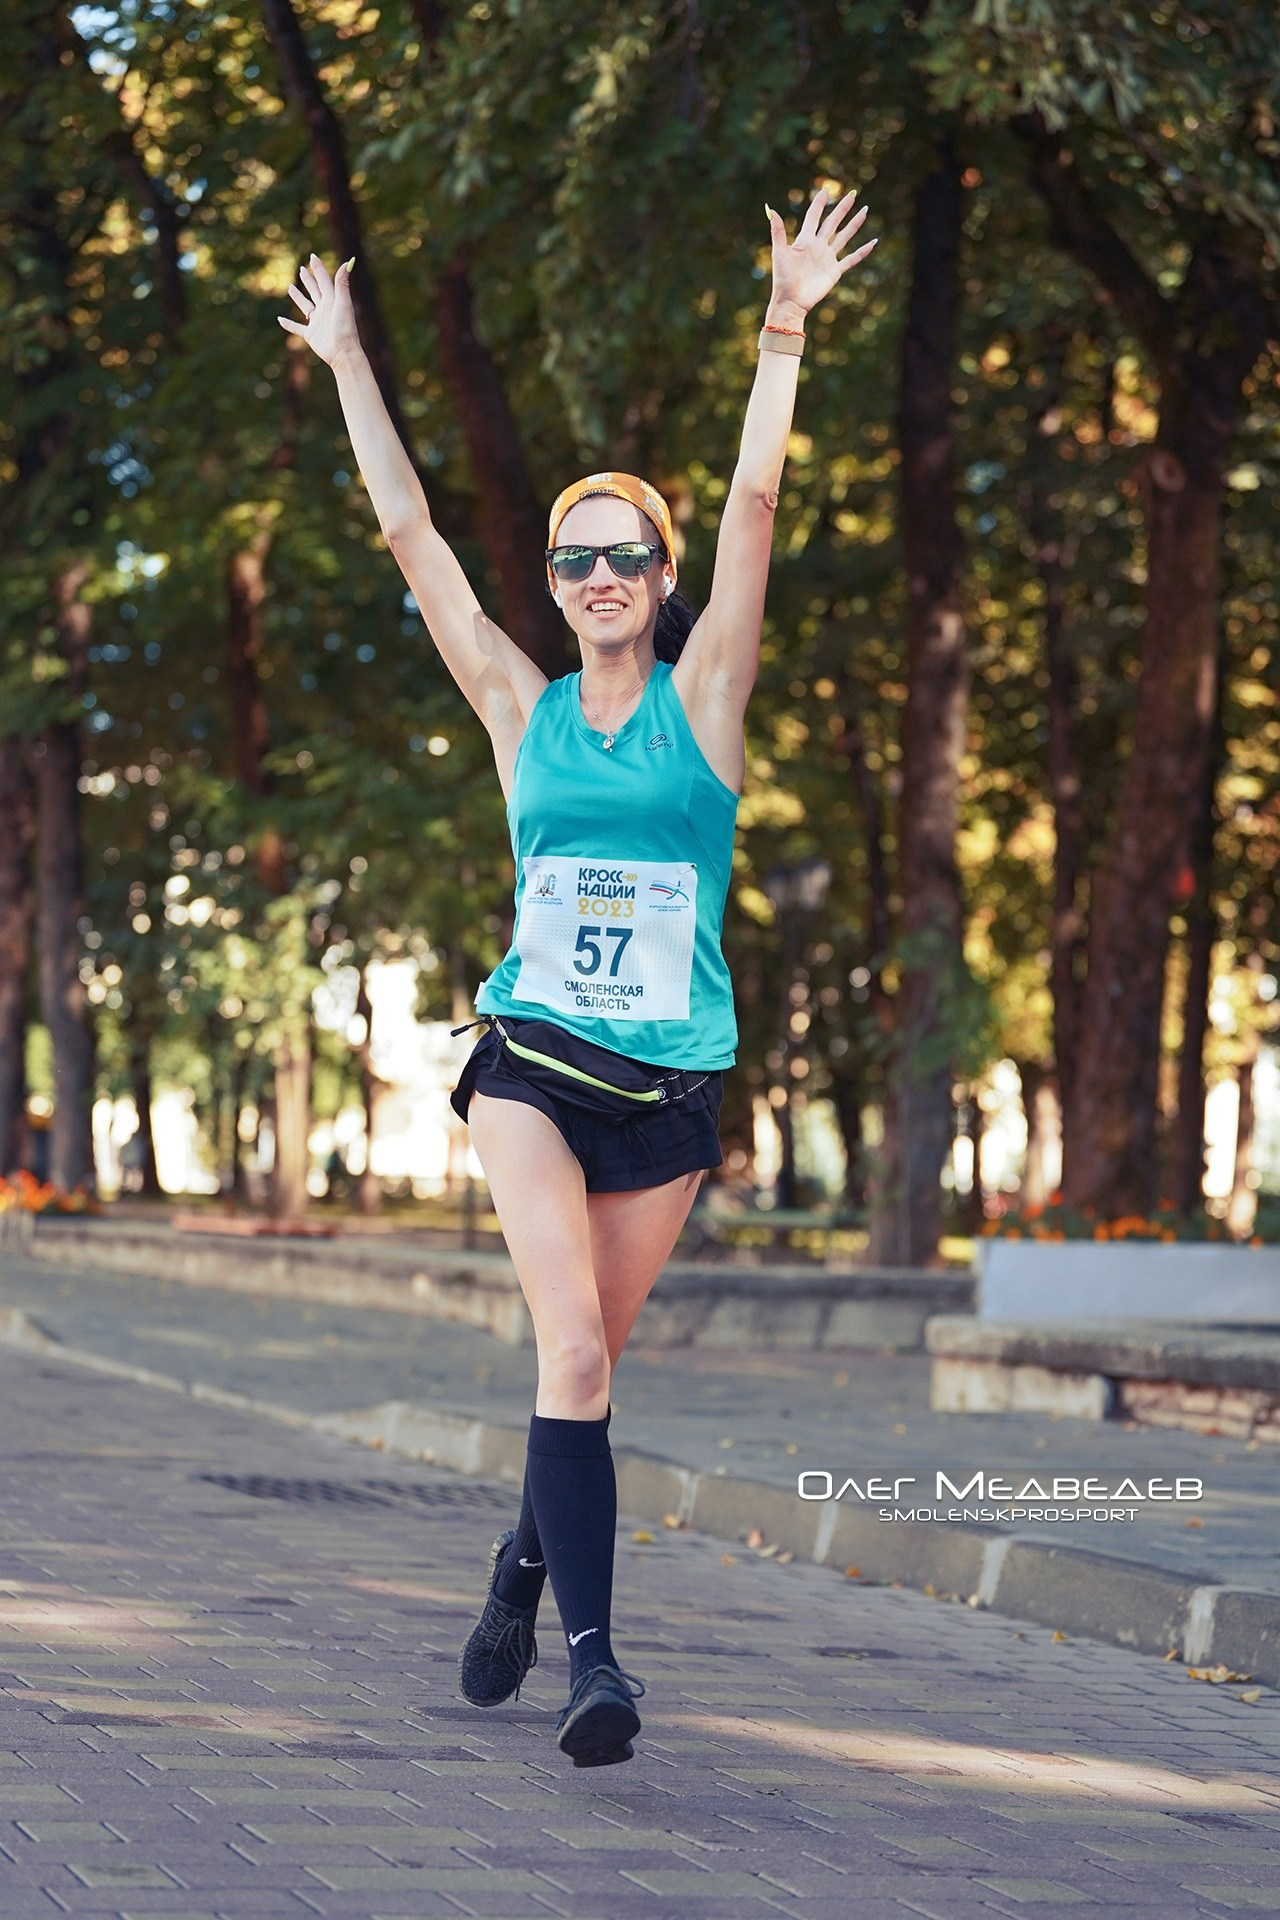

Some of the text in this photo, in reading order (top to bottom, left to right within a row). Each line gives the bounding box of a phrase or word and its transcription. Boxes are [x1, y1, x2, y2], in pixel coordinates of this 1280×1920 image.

[579, 868, 623, 883] КРОСС
[577, 883, 636, 899] НАЦИИ
[577, 898, 635, 917] 2023
[573, 925, 633, 976] 57
[565, 980, 643, 996] СМОЛЕНСКАЯ
[576, 995, 630, 1010] ОБЛАСТЬ
